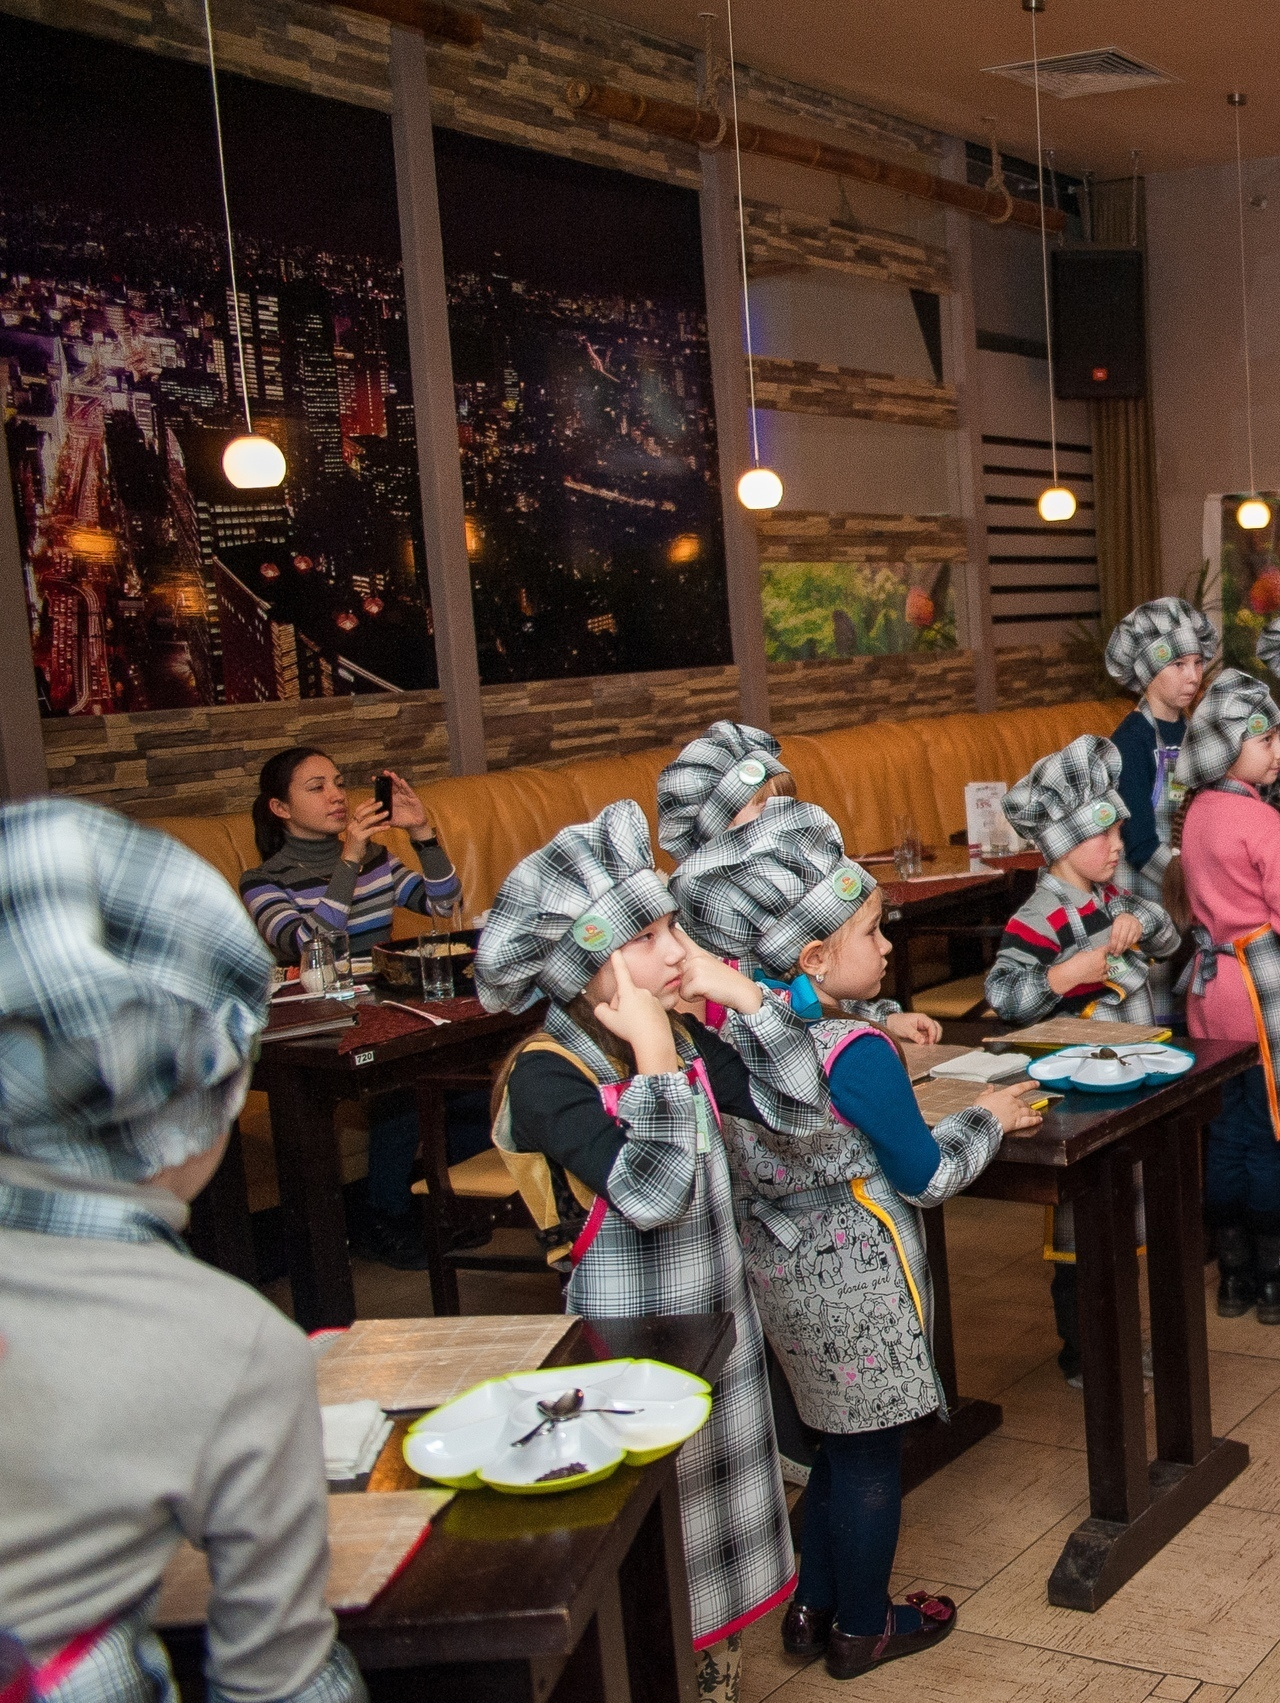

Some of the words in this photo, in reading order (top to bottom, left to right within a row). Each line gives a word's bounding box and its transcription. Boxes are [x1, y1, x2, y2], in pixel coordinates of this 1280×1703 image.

[356, 1052, 373, 1064] 720
[837, 1281, 869, 1299] gloria
[872, 1274, 891, 1290] girl
